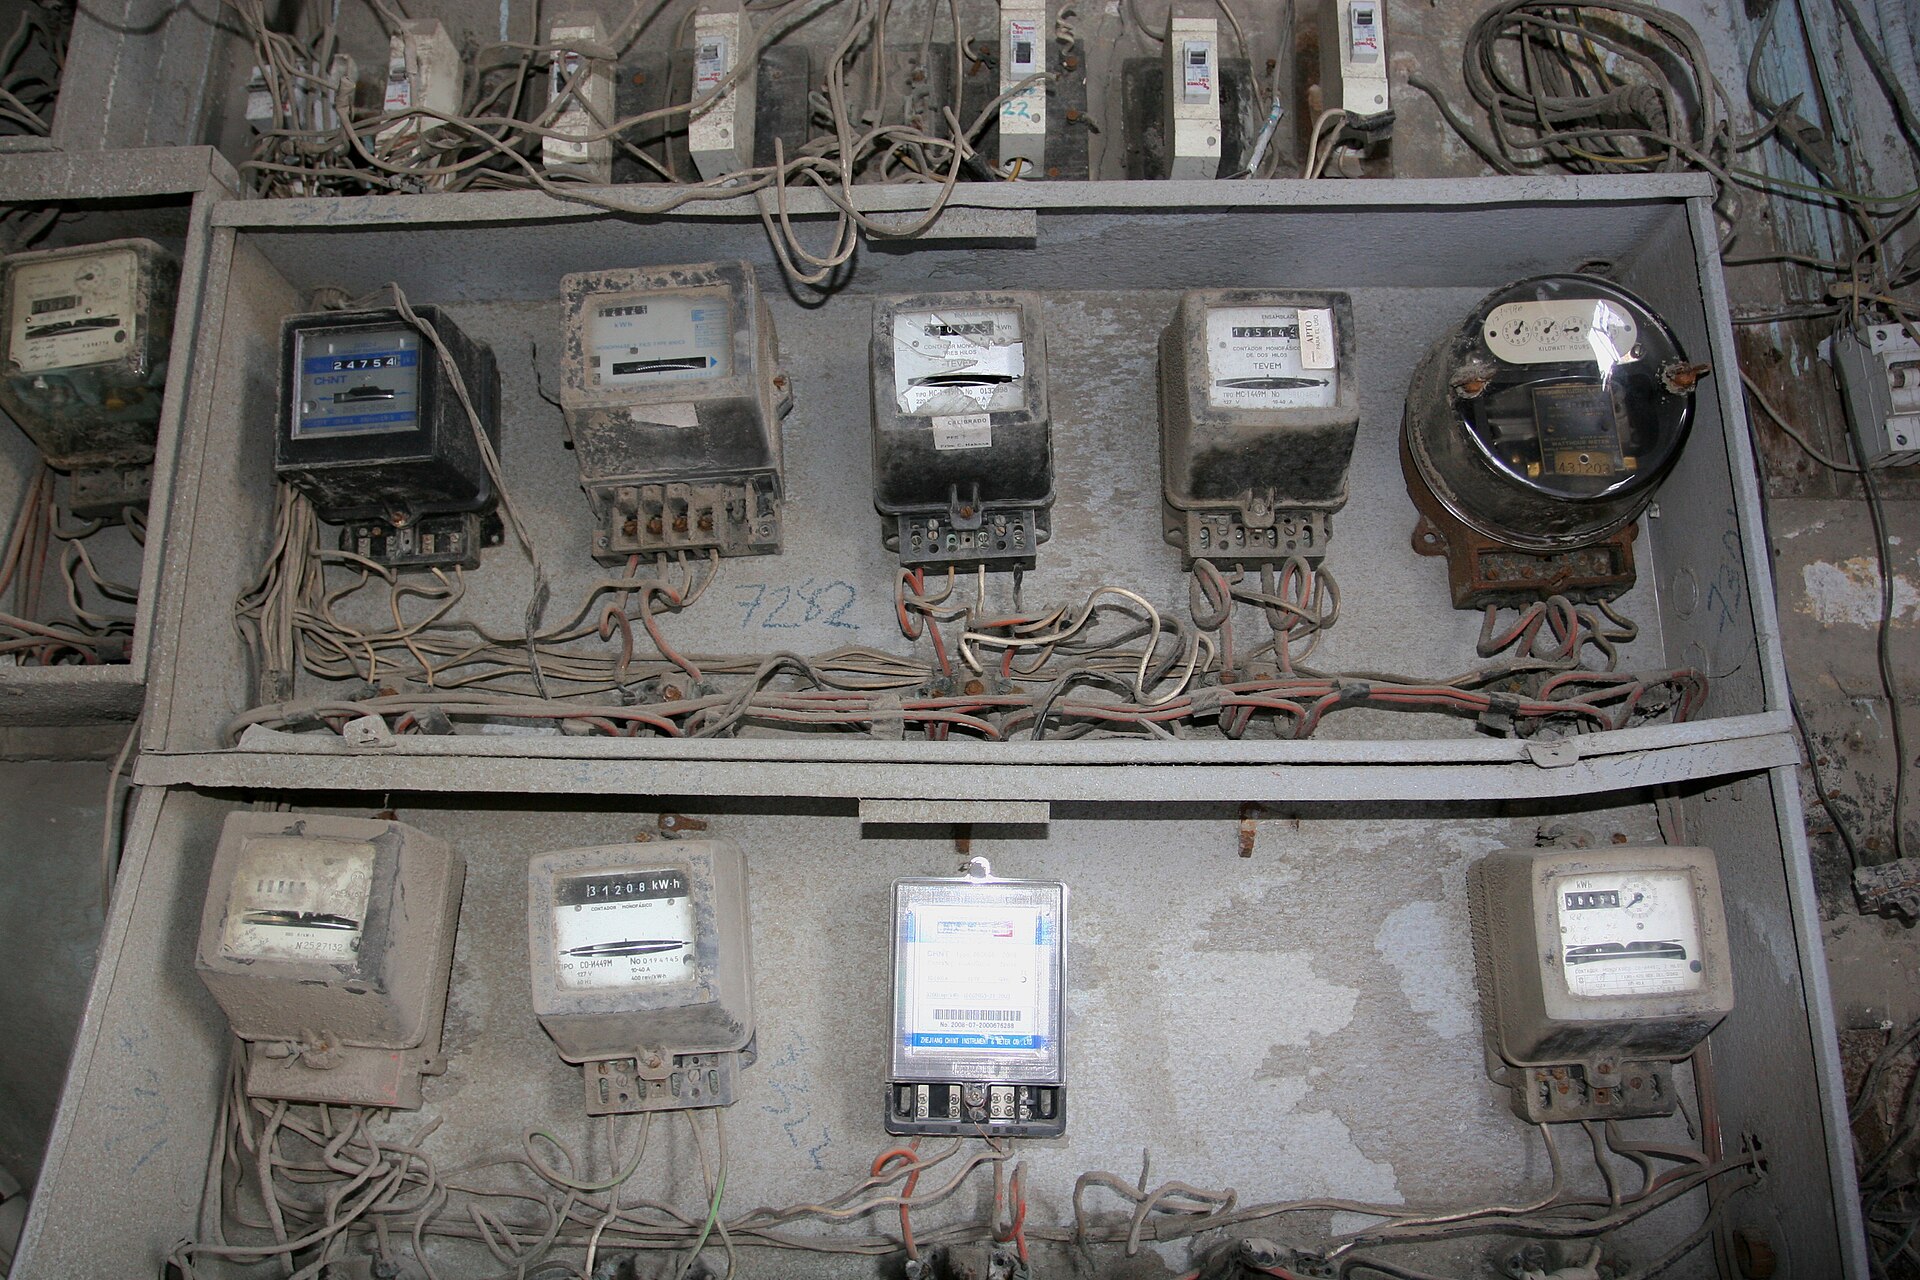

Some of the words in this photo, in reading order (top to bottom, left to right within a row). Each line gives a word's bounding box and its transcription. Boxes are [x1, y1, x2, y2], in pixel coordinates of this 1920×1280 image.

[1305, 320, 1315, 344] APTO
[333, 357, 396, 371] 24754
[1253, 362, 1282, 370] TEVEM
[590, 904, 617, 912] CONTADOR
